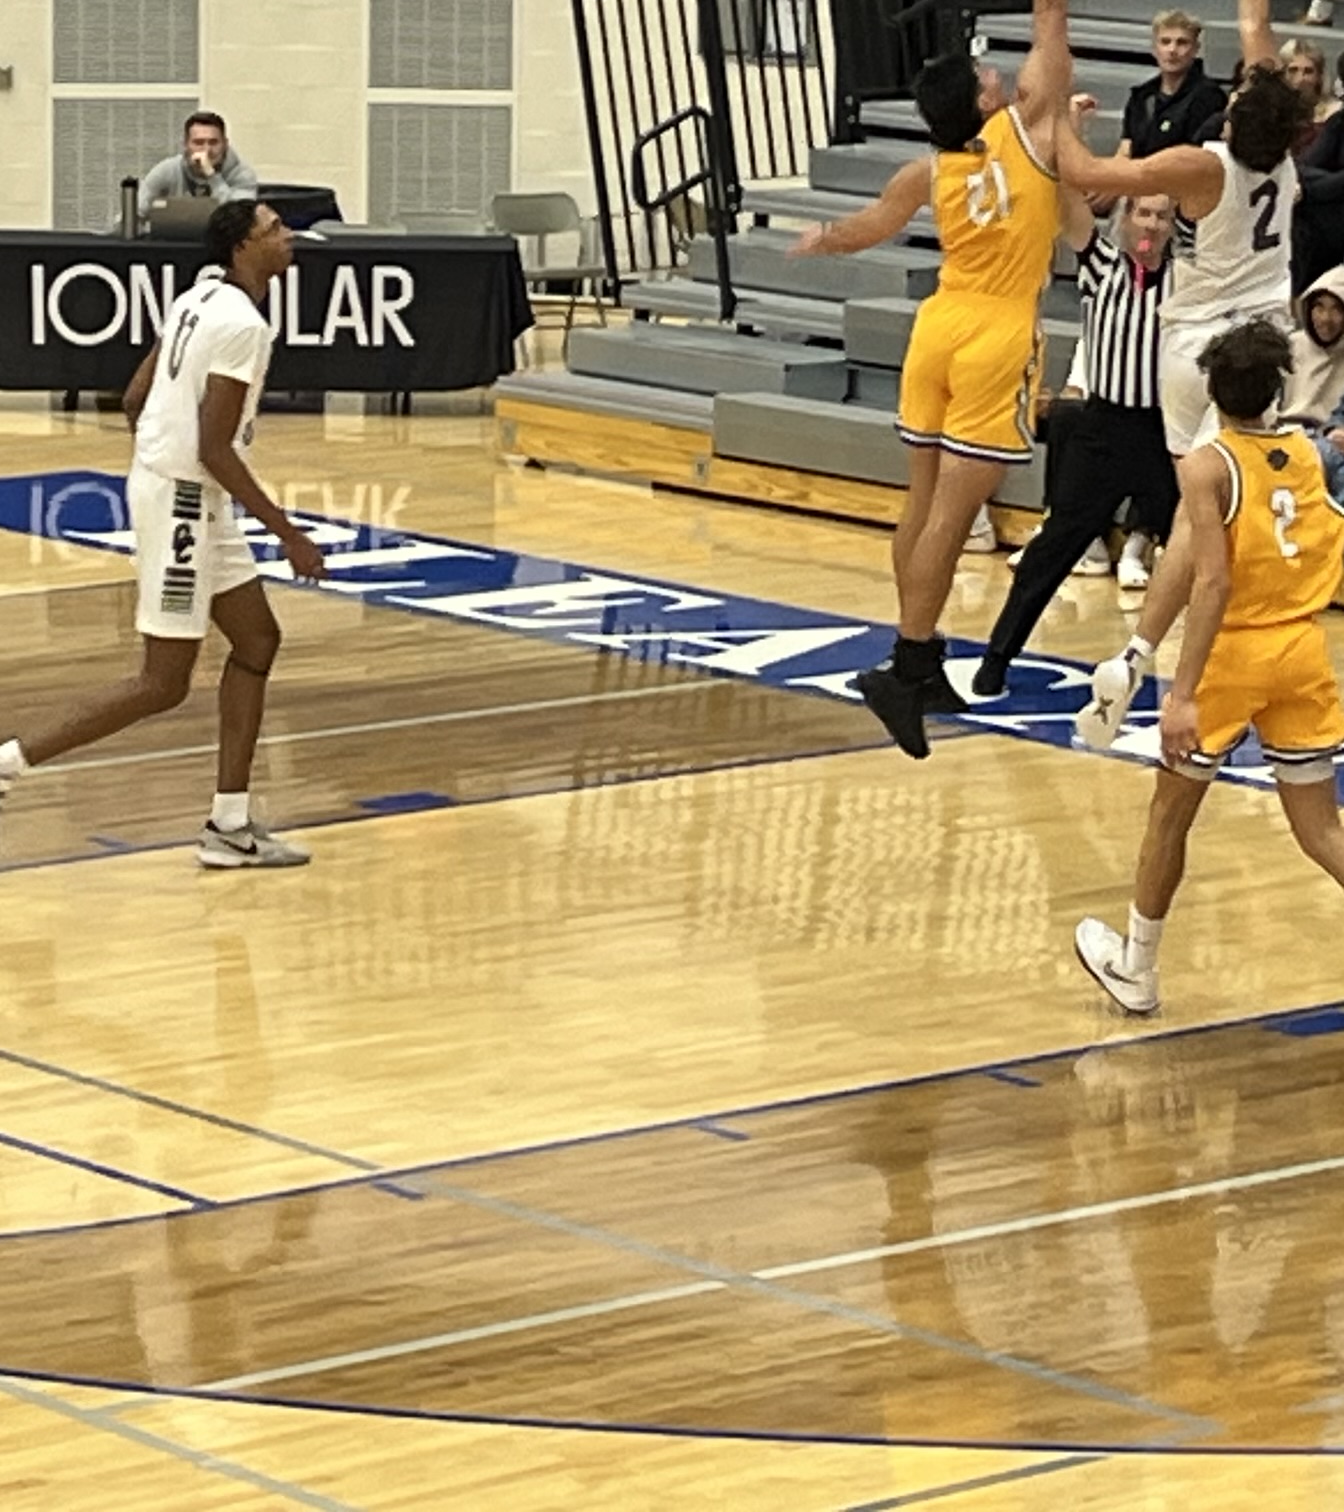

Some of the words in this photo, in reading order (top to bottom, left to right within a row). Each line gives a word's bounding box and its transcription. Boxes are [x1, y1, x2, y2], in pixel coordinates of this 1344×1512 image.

[1249, 179, 1281, 252] 2
[212, 264, 415, 347] LAR
[1270, 488, 1302, 558] 2
